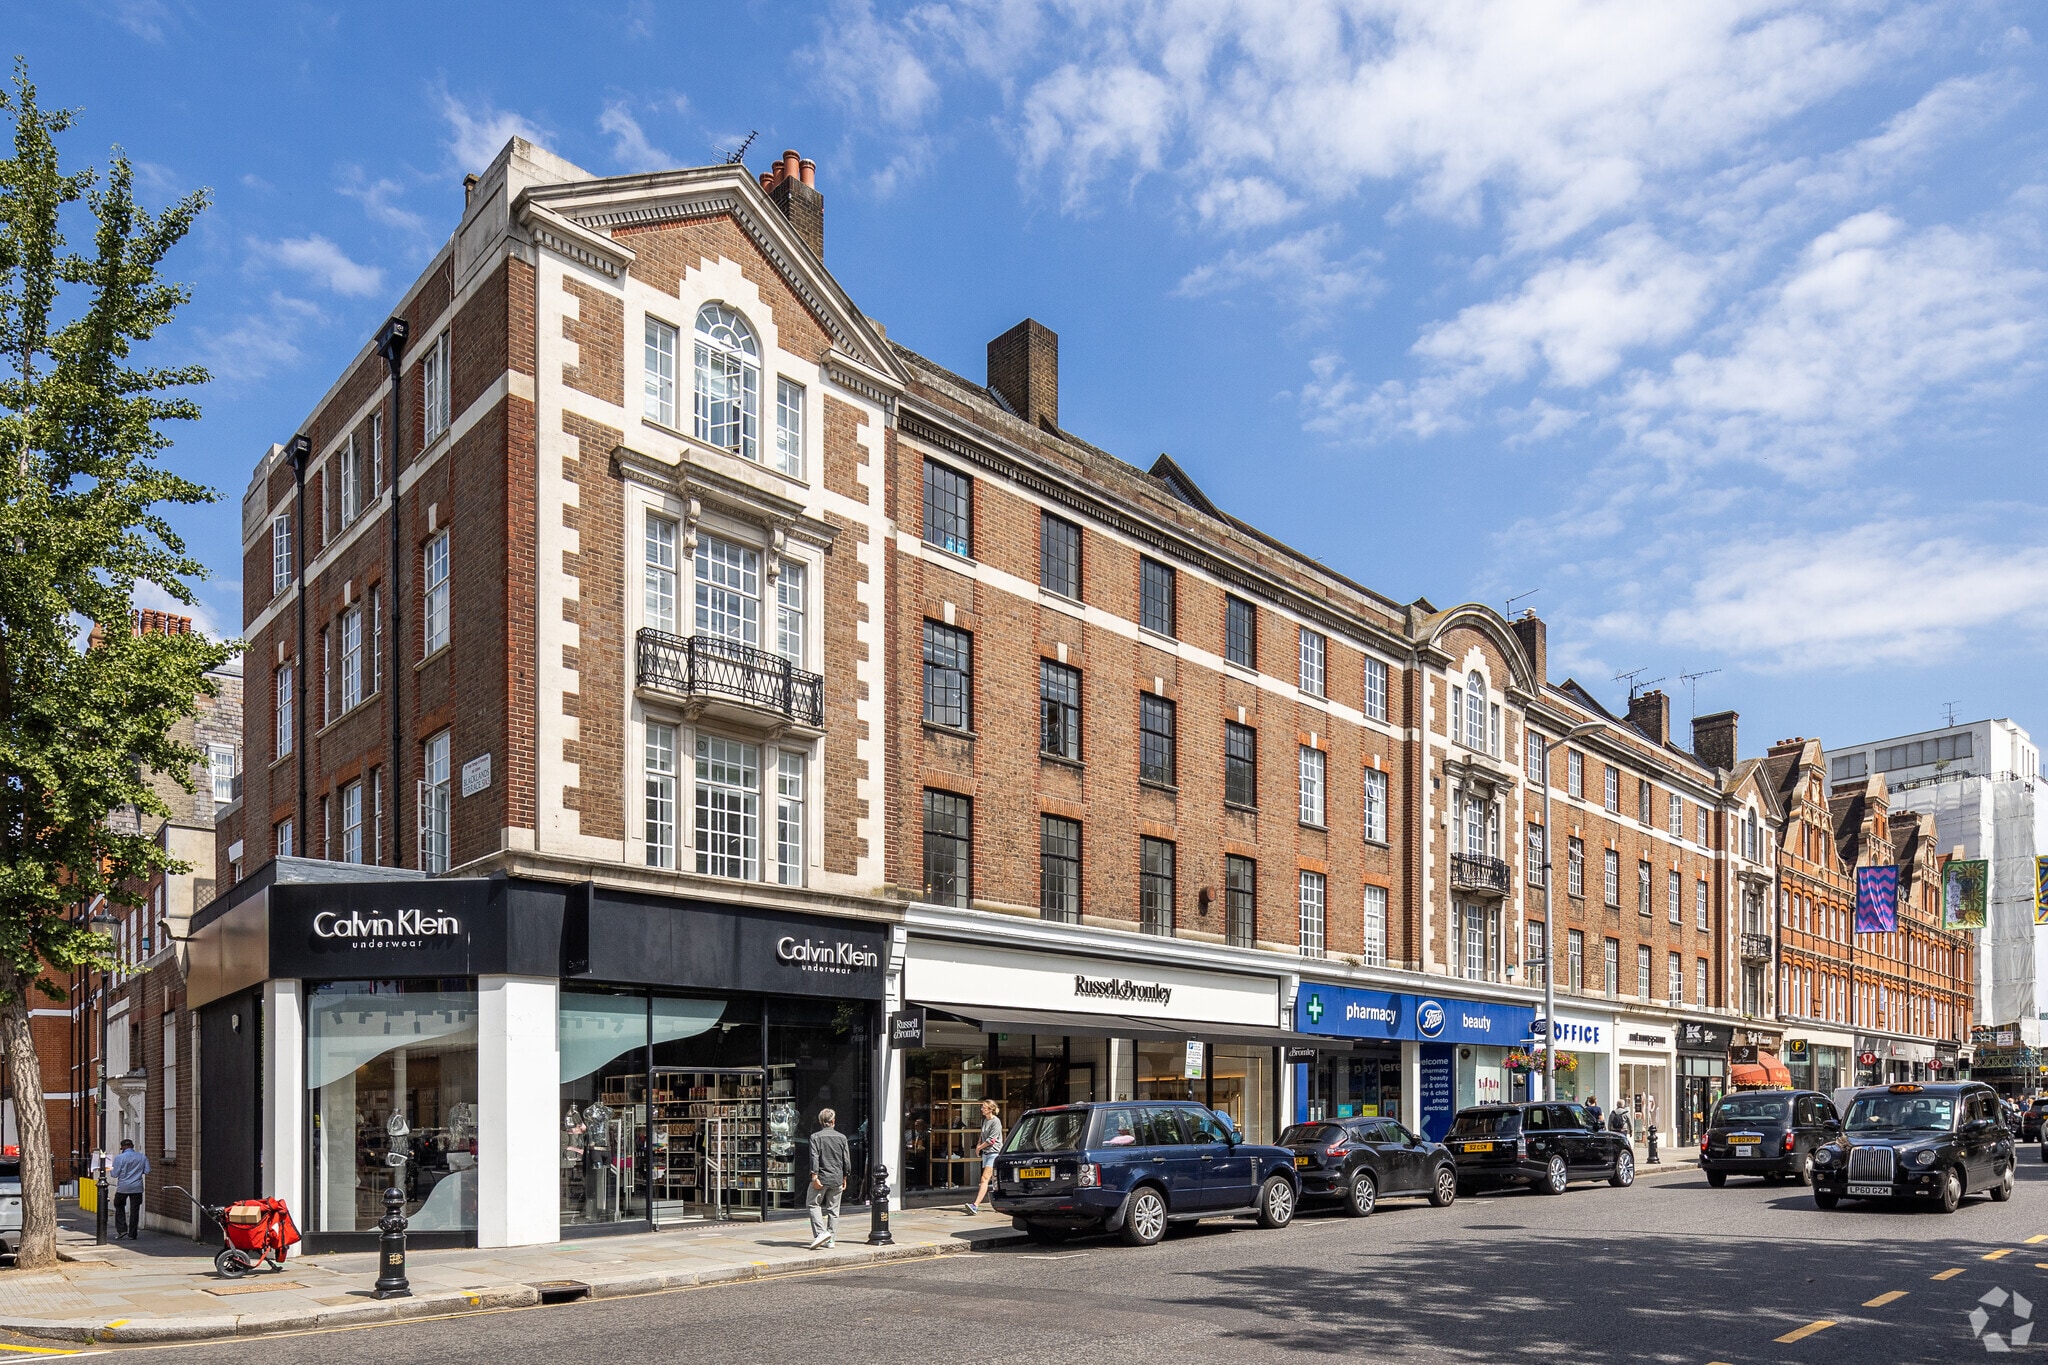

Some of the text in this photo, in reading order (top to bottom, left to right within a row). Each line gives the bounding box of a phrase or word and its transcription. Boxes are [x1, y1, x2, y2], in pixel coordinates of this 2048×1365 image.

[313, 908, 459, 938] Calvin Klein
[352, 939, 423, 948] underwear
[776, 936, 878, 968] Calvin Klein
[802, 964, 851, 975] underwear
[1346, 1002, 1397, 1025] pharmacy
[1423, 1009, 1442, 1029] Boots
[1462, 1013, 1491, 1032] beauty
[896, 1018, 918, 1029] Russell
[1554, 1023, 1600, 1044] OFFICE
[1850, 1186, 1870, 1194] LP60
